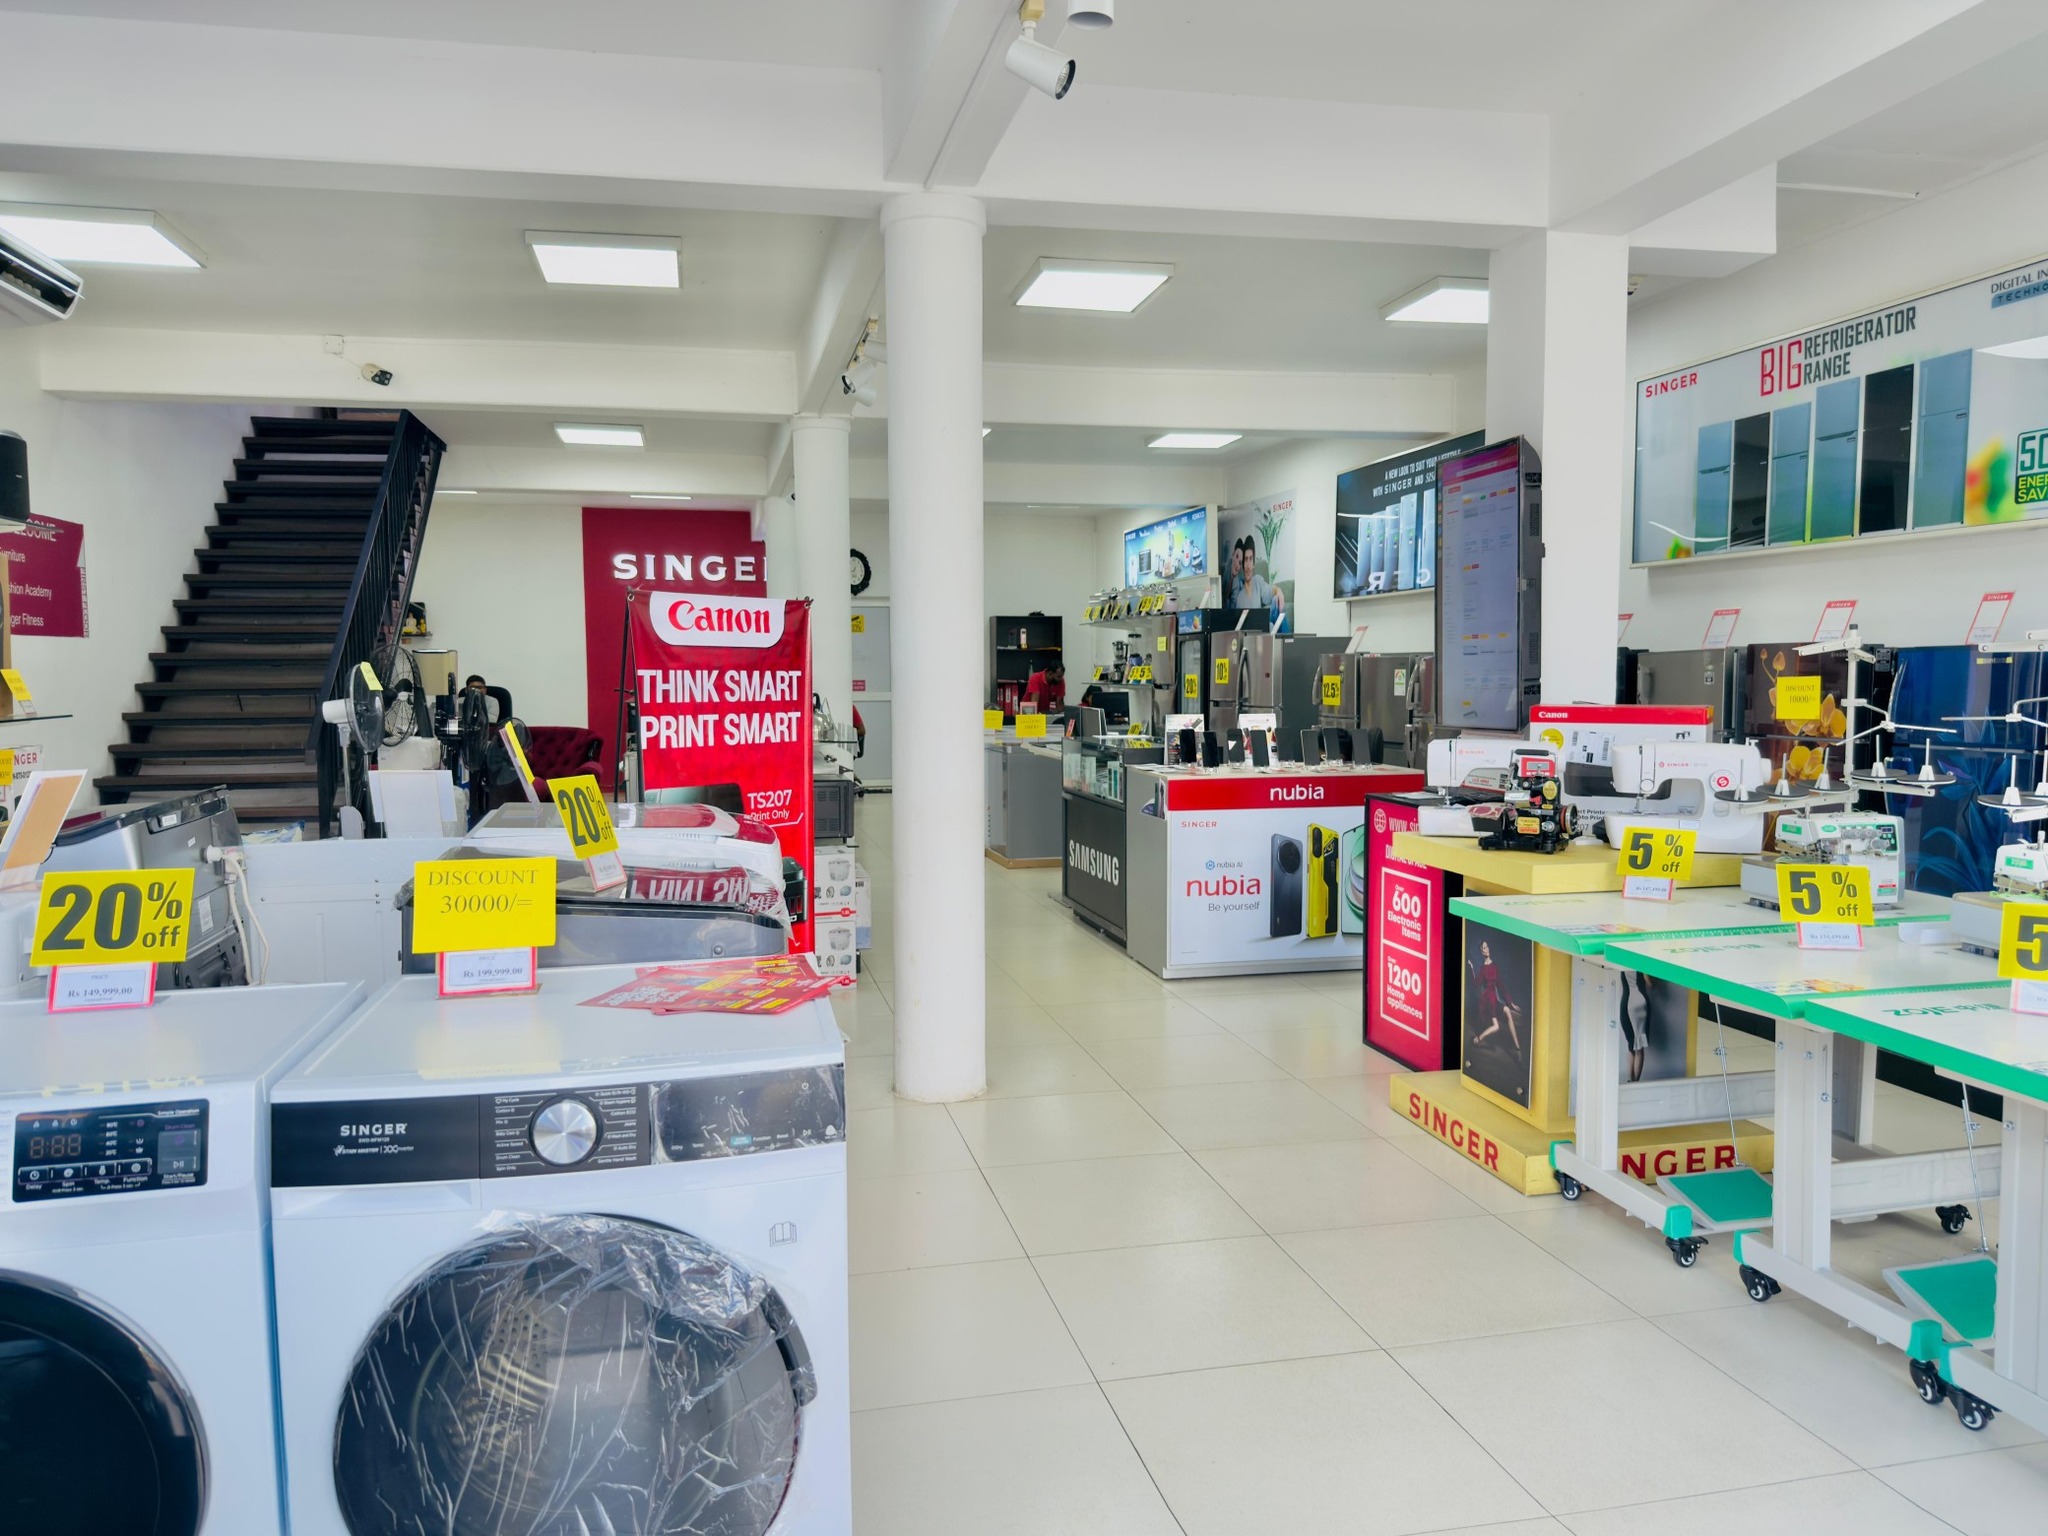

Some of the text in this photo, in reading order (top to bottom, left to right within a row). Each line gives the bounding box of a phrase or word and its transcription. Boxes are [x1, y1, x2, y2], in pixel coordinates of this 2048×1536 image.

[1991, 273, 2034, 294] DIGITAL
[1804, 306, 1916, 360] REFRIGERATOR
[1760, 339, 1851, 397] BIG RANGE
[1646, 371, 1698, 398] SINGER
[1384, 478, 1412, 494] SINGER
[1415, 474, 1424, 486] AND
[1272, 500, 1293, 513] SINGER
[611, 553, 767, 583] SINGE
[25, 584, 52, 601] Academy
[22, 613, 44, 627] Fitness
[667, 599, 771, 634] Canon
[637, 668, 801, 704] THINK SMART
[1538, 710, 1568, 719] Canon
[639, 711, 801, 750] PRINT SMART
[14, 752, 38, 767] NGER
[747, 789, 793, 810] TS207
[1270, 785, 1325, 801] nubia
[558, 786, 606, 847] 20%
[771, 809, 790, 821] Only
[1181, 821, 1218, 829] SINGER
[601, 822, 615, 841] off
[1069, 839, 1119, 886] SAMSUNG
[1217, 860, 1236, 868] nubia
[1662, 861, 1680, 873] off
[428, 869, 540, 886] DISCOUNT
[1186, 875, 1261, 897] nubia
[440, 893, 532, 914] 30000/=
[1208, 900, 1261, 914] Be yourself
[1392, 891, 1422, 918] 600
[1837, 904, 1858, 917] off
[42, 881, 183, 951] 20%
[1388, 910, 1422, 931] Electronic
[142, 925, 181, 948] off
[1401, 924, 1421, 942] Items
[463, 967, 523, 978] Rs 199,999.00
[1388, 961, 1422, 996] 1200
[68, 986, 133, 998] Rs 149,999.00
[1387, 984, 1405, 1000] Home
[1387, 996, 1423, 1019] appliances
[340, 1123, 408, 1137] SINGER
[1409, 1092, 1499, 1173] SINGER
[1622, 1145, 1737, 1180] NGER
[26, 1183, 42, 1191] Delay
